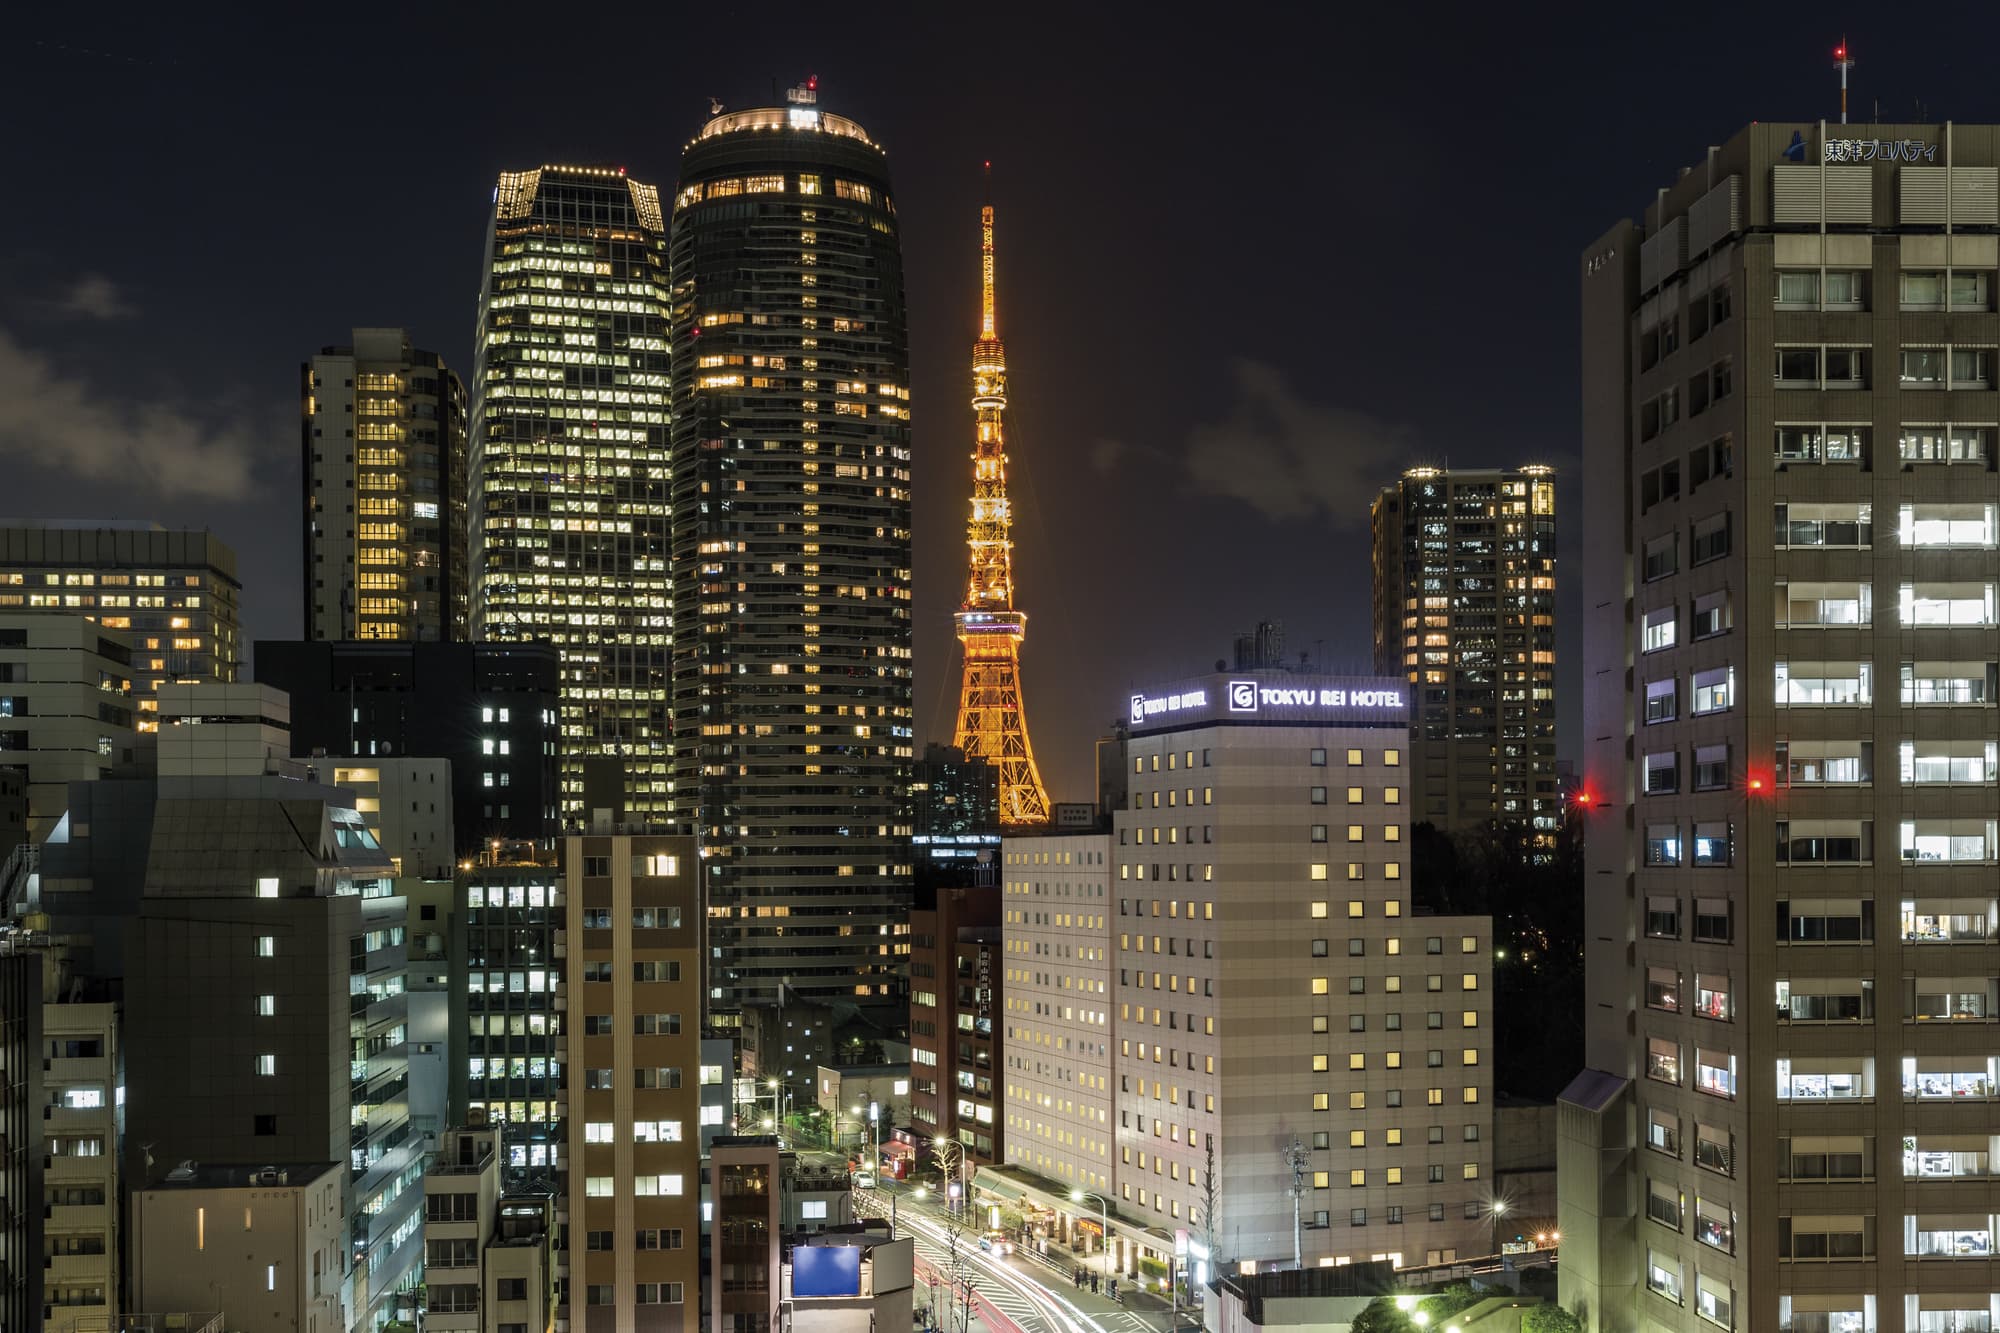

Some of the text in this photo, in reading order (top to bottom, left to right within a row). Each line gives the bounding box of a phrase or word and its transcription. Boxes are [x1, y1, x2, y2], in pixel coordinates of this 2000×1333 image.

[1825, 139, 1938, 161] 東洋プロパティ
[1260, 688, 1404, 708] TOKYU REI HOTEL
